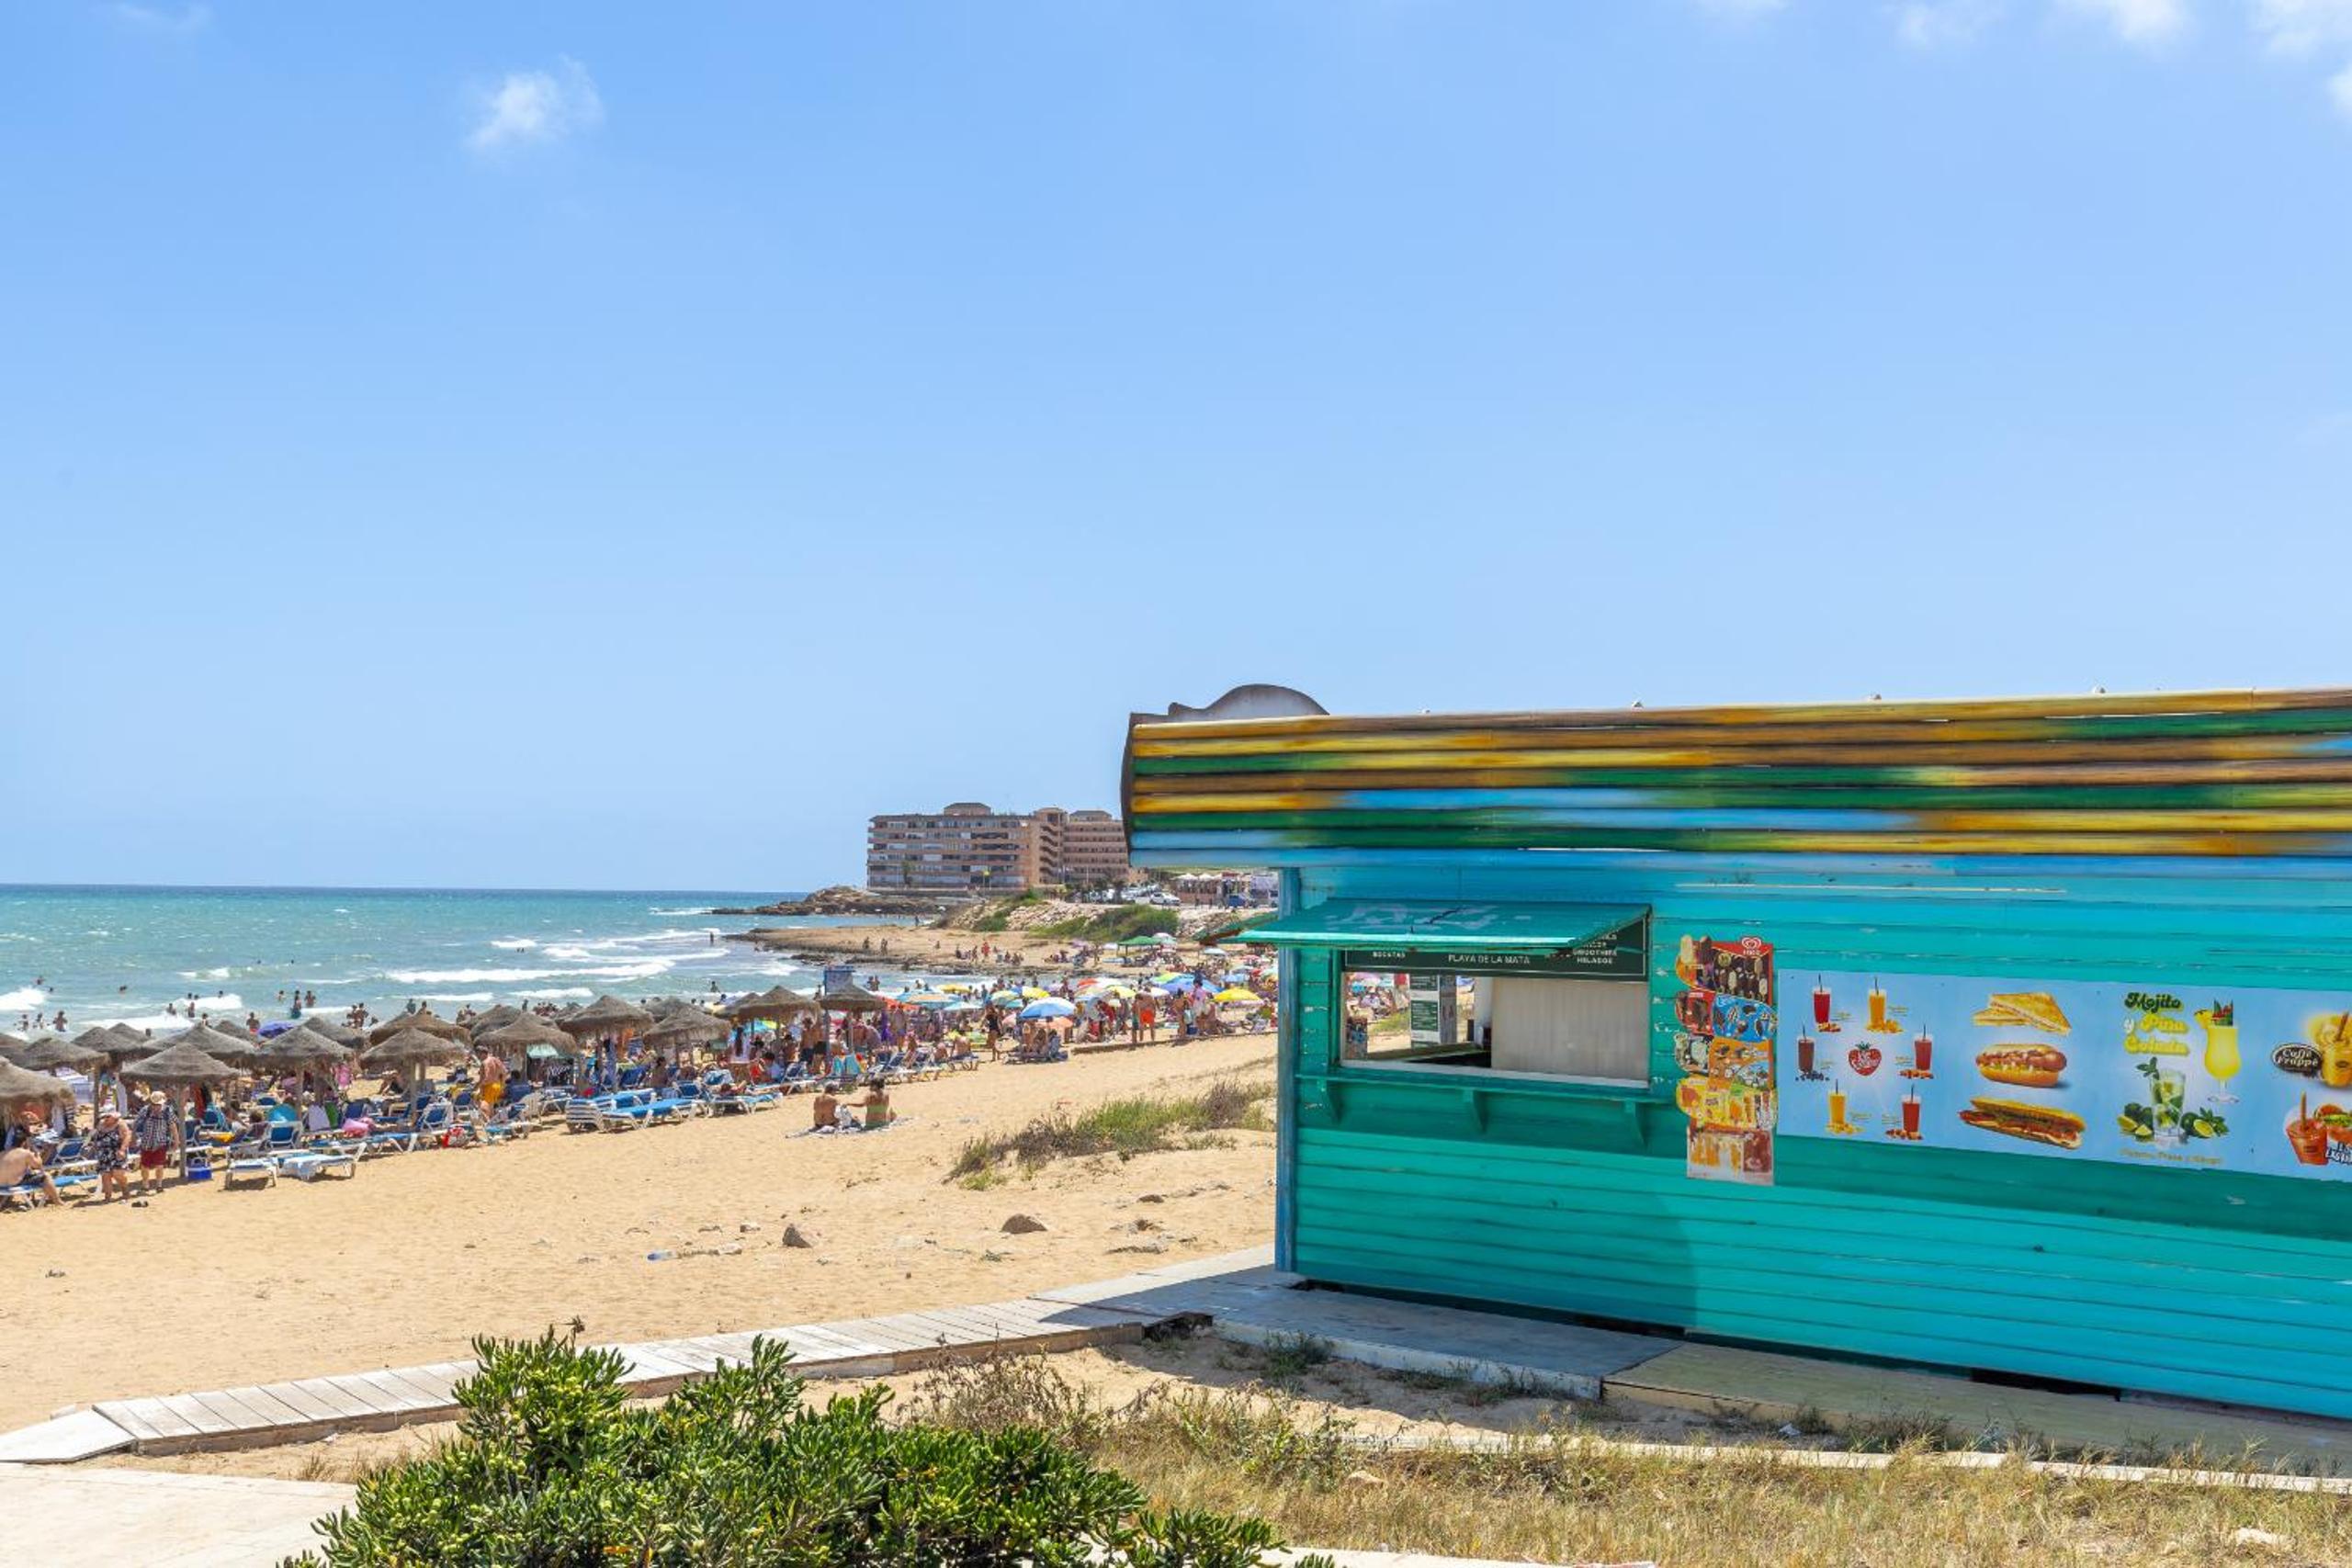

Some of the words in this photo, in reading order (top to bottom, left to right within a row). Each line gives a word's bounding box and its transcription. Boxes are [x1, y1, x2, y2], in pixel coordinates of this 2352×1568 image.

[1448, 954, 1476, 964] PLAYA
[1477, 955, 1489, 964] DE
[1491, 955, 1503, 964] LA
[1505, 956, 1531, 964] MATA
[2124, 992, 2183, 1013] Mojito
